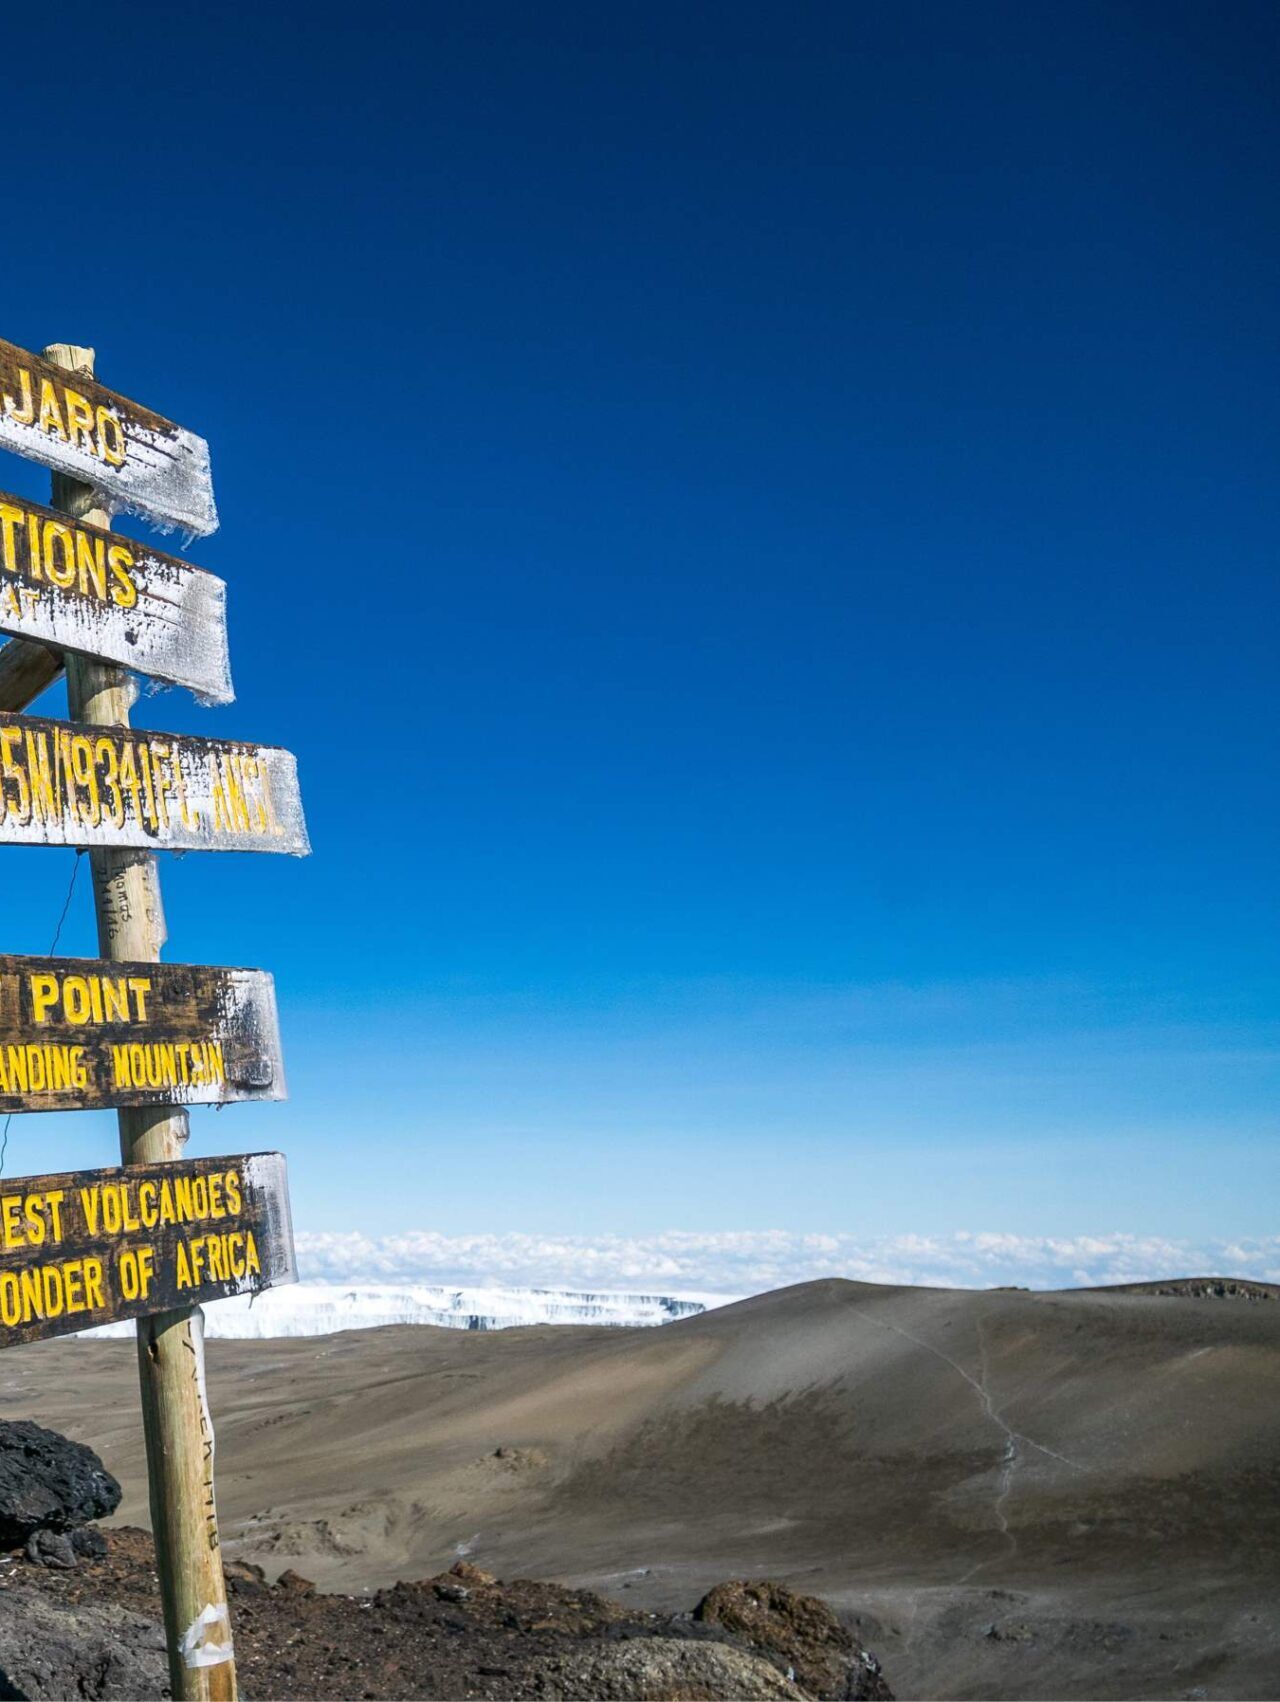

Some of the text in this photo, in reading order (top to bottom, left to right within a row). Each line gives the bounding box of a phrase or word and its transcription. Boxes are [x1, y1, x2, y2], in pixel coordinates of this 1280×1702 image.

[29, 973, 152, 1027] POINT
[110, 1040, 227, 1090] MOUNTAIN
[79, 1169, 243, 1237] VOLCANOES
[118, 1244, 155, 1302] OF
[175, 1230, 262, 1291] AFRICA
